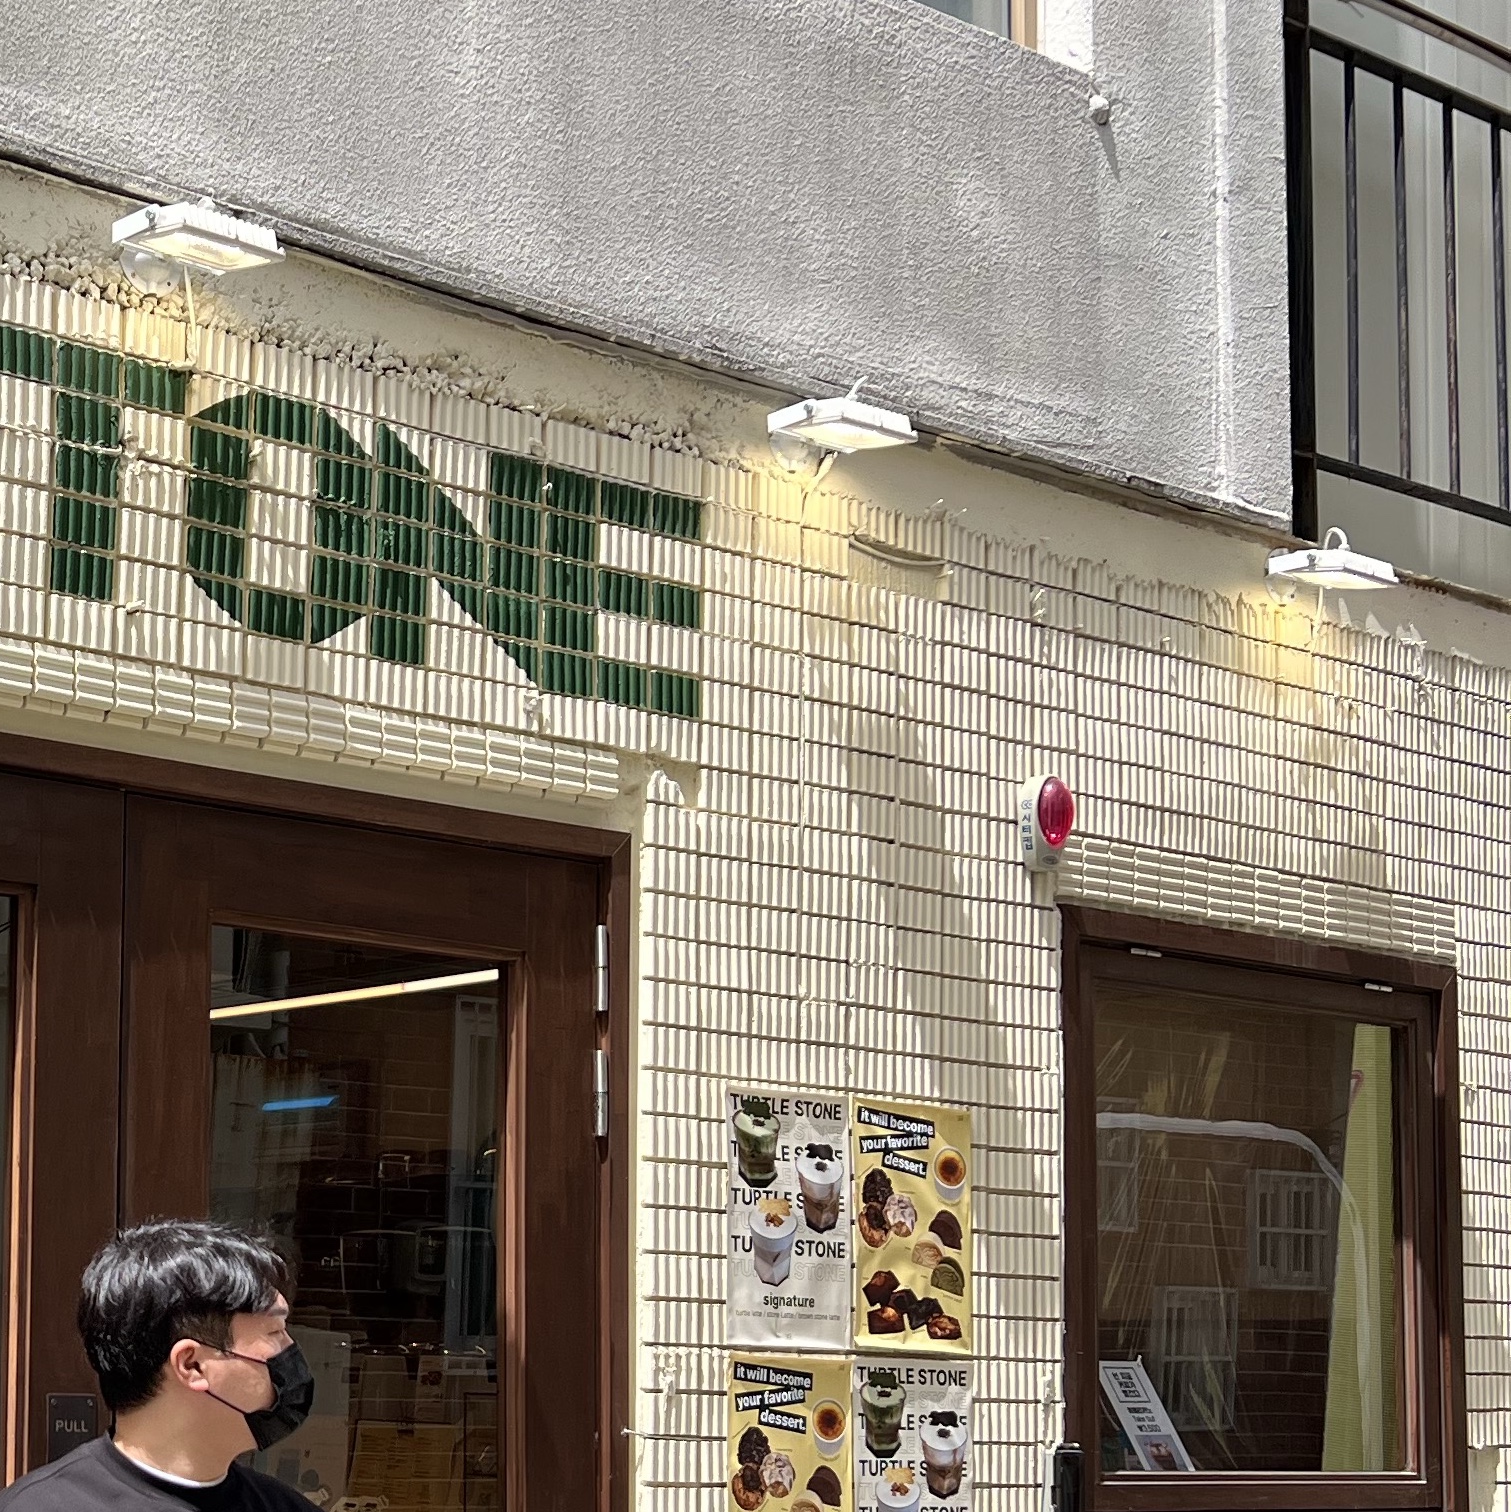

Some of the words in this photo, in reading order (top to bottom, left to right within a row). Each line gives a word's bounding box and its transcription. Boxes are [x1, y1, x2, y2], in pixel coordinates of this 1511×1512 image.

[794, 1099, 842, 1120] STONE
[860, 1108, 870, 1122] it
[870, 1112, 888, 1127] will
[890, 1115, 934, 1135] become
[861, 1136, 886, 1153] your
[887, 1134, 928, 1149] favorite
[884, 1153, 926, 1176] dessert.
[794, 1239, 845, 1259] STONE
[763, 1292, 815, 1309] signature
[736, 1364, 745, 1378] it
[745, 1366, 768, 1382] will
[769, 1368, 811, 1388] become
[918, 1368, 967, 1387] STONE
[737, 1393, 762, 1411] your
[764, 1387, 804, 1405] favorite
[55, 1419, 89, 1433] PULL
[760, 1409, 806, 1431] dessert.
